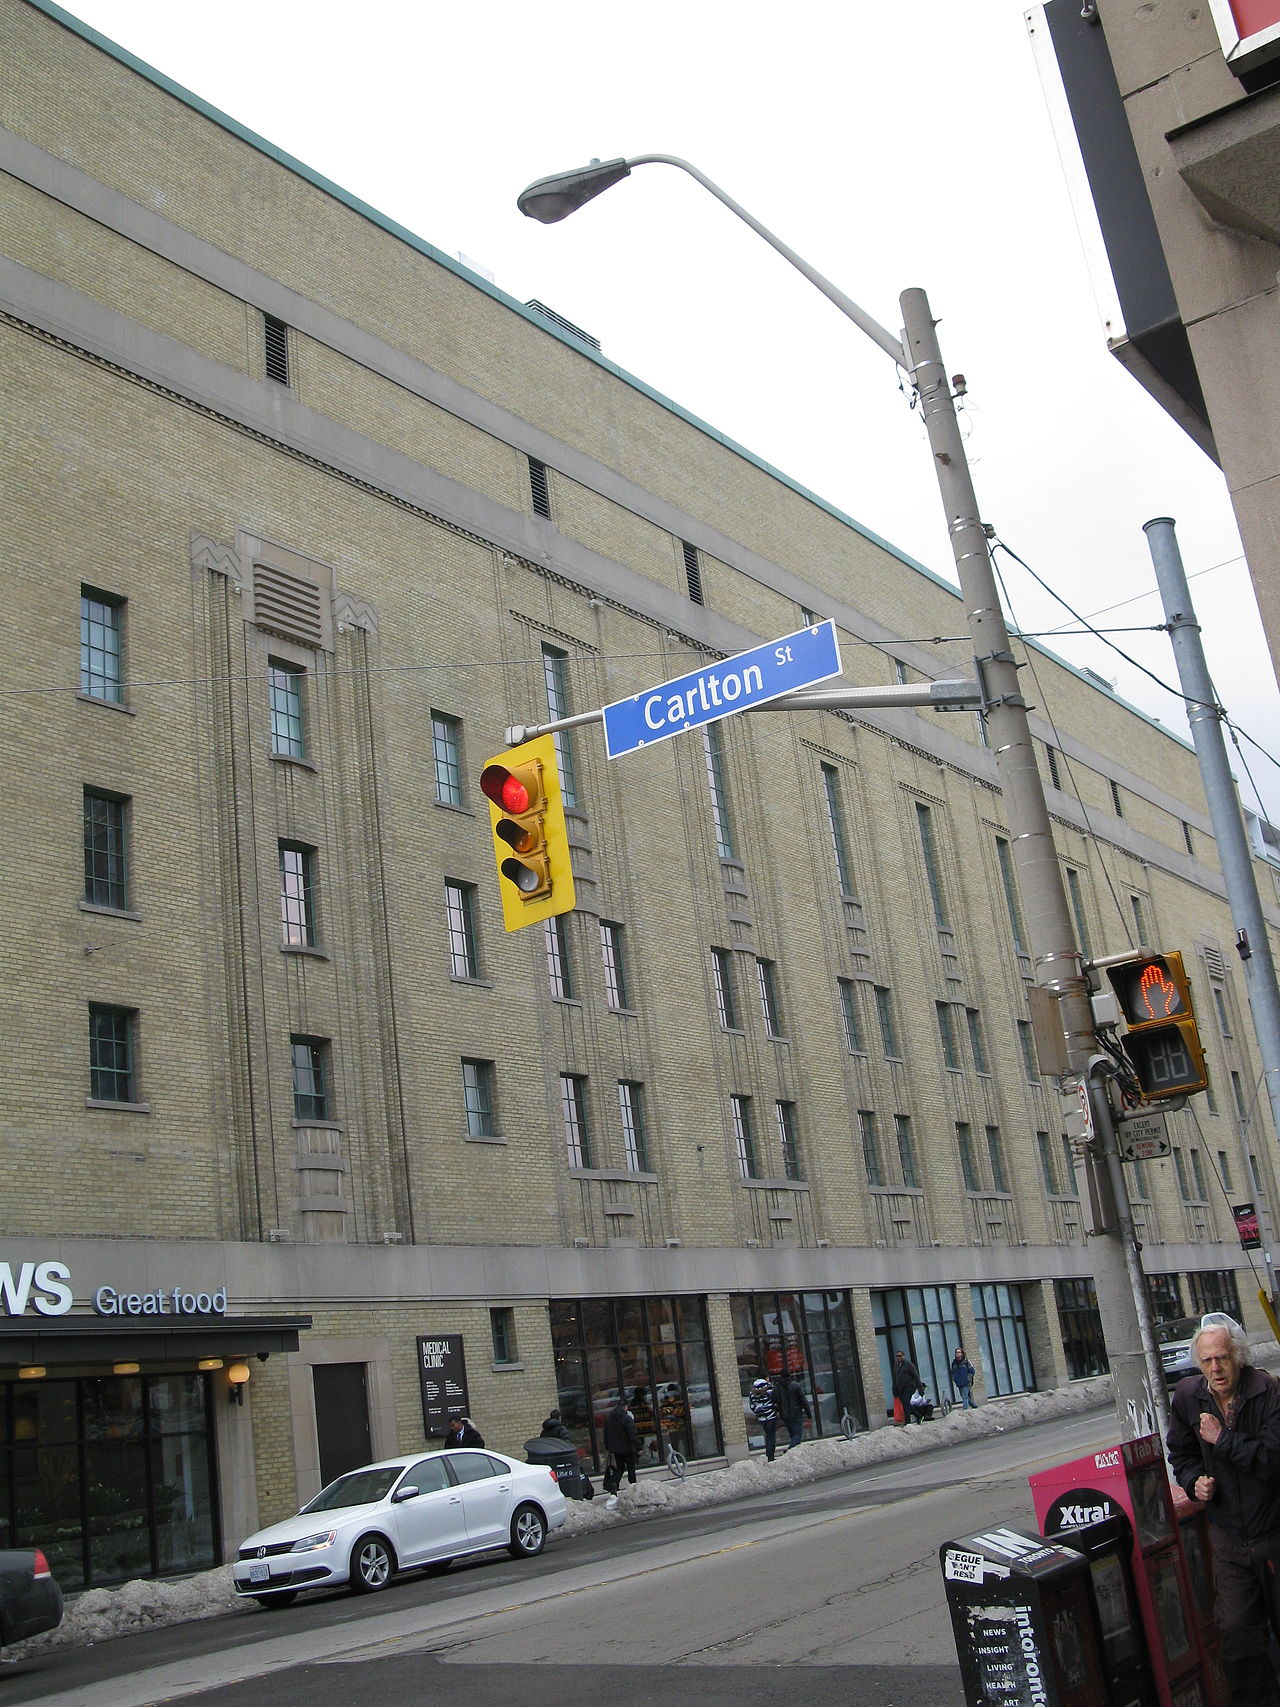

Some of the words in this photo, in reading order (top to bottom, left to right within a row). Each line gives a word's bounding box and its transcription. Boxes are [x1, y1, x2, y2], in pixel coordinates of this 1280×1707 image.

[644, 664, 764, 730] Carlton
[774, 645, 794, 666] St
[1133, 1121, 1150, 1129] EXCEPT
[94, 1285, 168, 1316] Great
[171, 1286, 228, 1315] food
[422, 1341, 452, 1356] MEDICAL
[423, 1355, 445, 1369] CLINIC
[1060, 1502, 1110, 1525] Xtra!
[972, 1528, 1043, 1558] IN
[949, 1552, 982, 1565] EGUE
[953, 1570, 976, 1580] READ
[982, 1628, 1007, 1637] NEWS
[978, 1645, 1009, 1655] INSIGHT
[986, 1663, 1014, 1672] LIVING
[1003, 1699, 1020, 1707] ART
